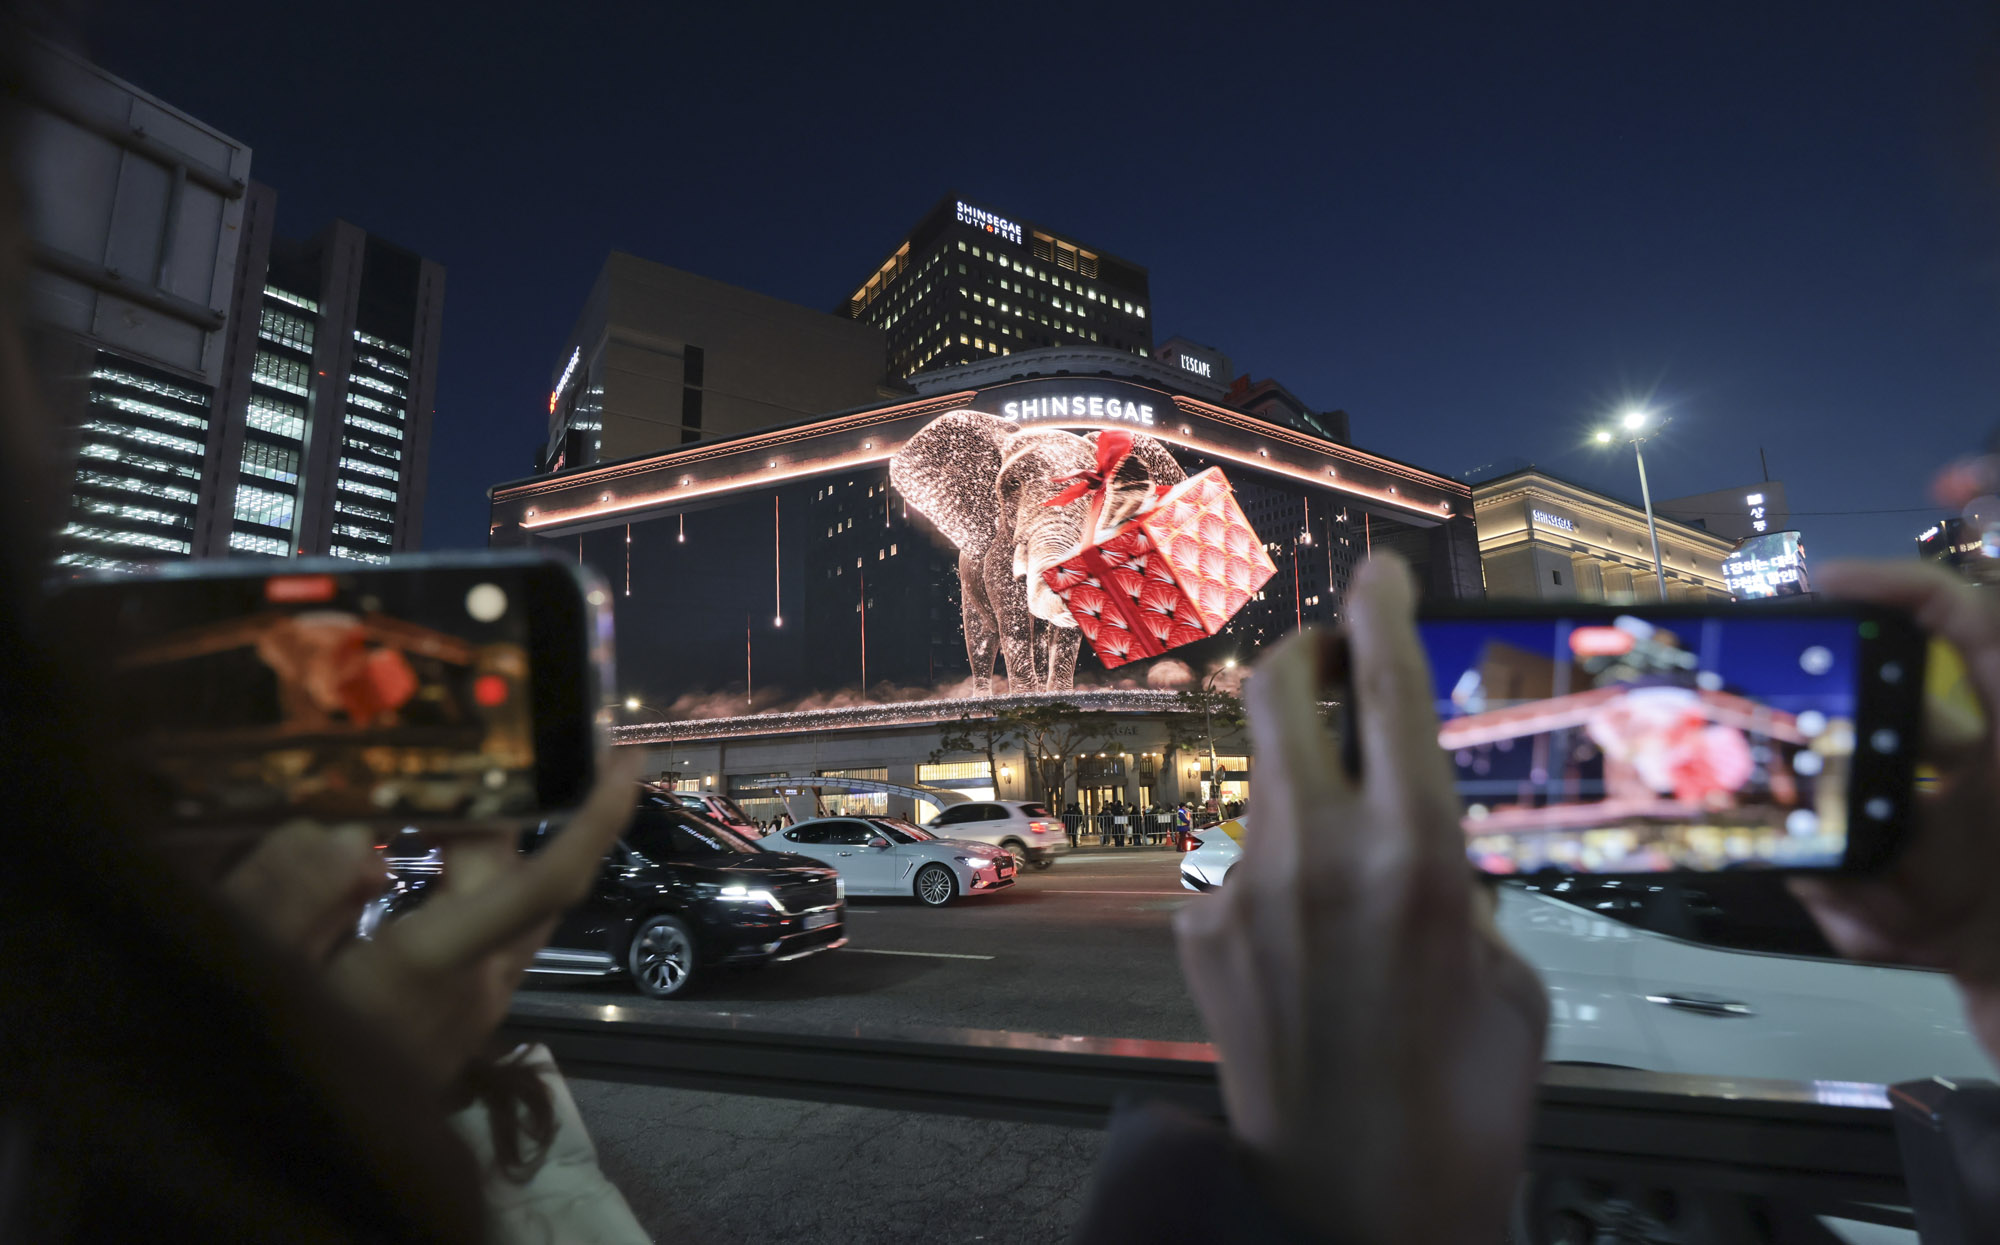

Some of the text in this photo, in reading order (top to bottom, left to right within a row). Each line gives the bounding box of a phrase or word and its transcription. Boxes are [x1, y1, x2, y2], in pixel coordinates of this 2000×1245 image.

[957, 201, 1022, 236] SHINSEGAE
[957, 212, 1022, 245] DUTY FREE
[1181, 354, 1211, 378] L'ESCAPE
[1004, 396, 1154, 425] SHINSEGAE
[1532, 509, 1574, 532] SHINSEGAE
